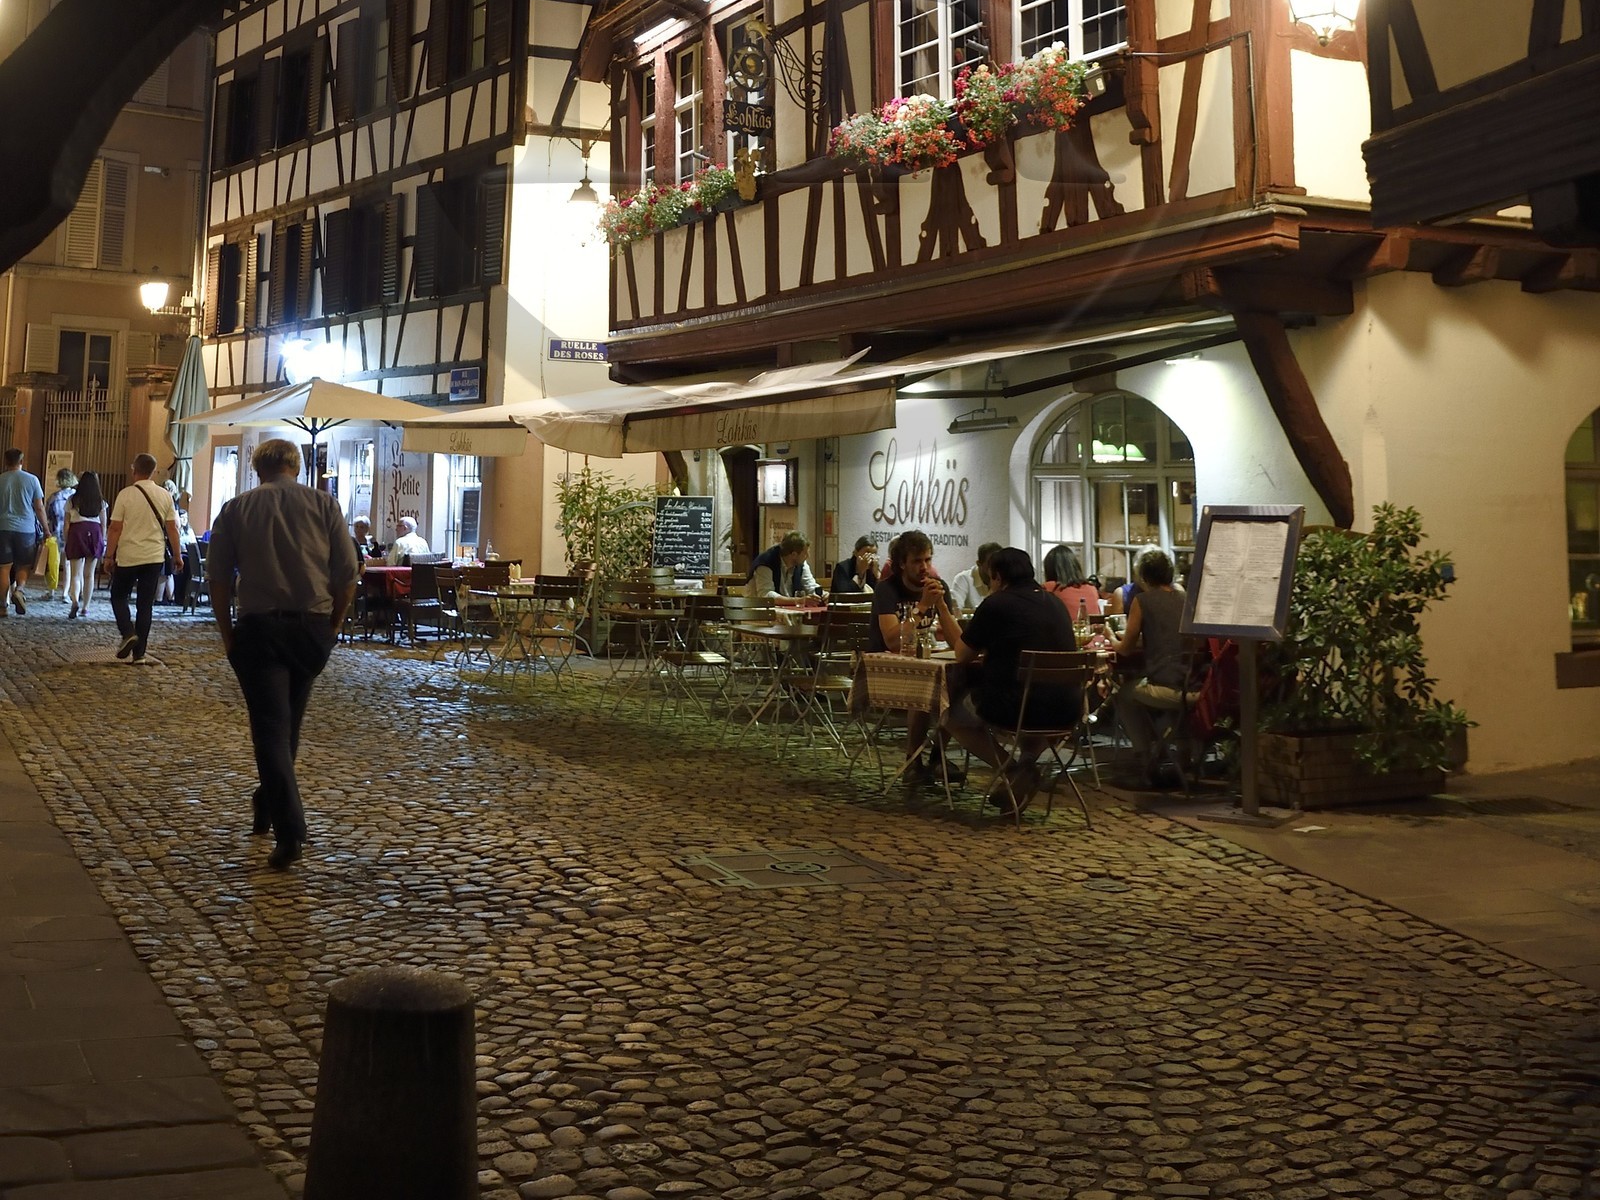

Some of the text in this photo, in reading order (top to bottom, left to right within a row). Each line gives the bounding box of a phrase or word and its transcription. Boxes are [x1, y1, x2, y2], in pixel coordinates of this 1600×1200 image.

[726, 102, 772, 133] Lohkäs
[553, 350, 604, 360] DES ROSES
[561, 341, 598, 351] RUELLE
[717, 411, 758, 444] Lohkäs
[391, 439, 405, 469] La
[391, 468, 421, 501] Petite
[868, 436, 970, 525] Lohkäs
[929, 533, 969, 547] TRADITION
